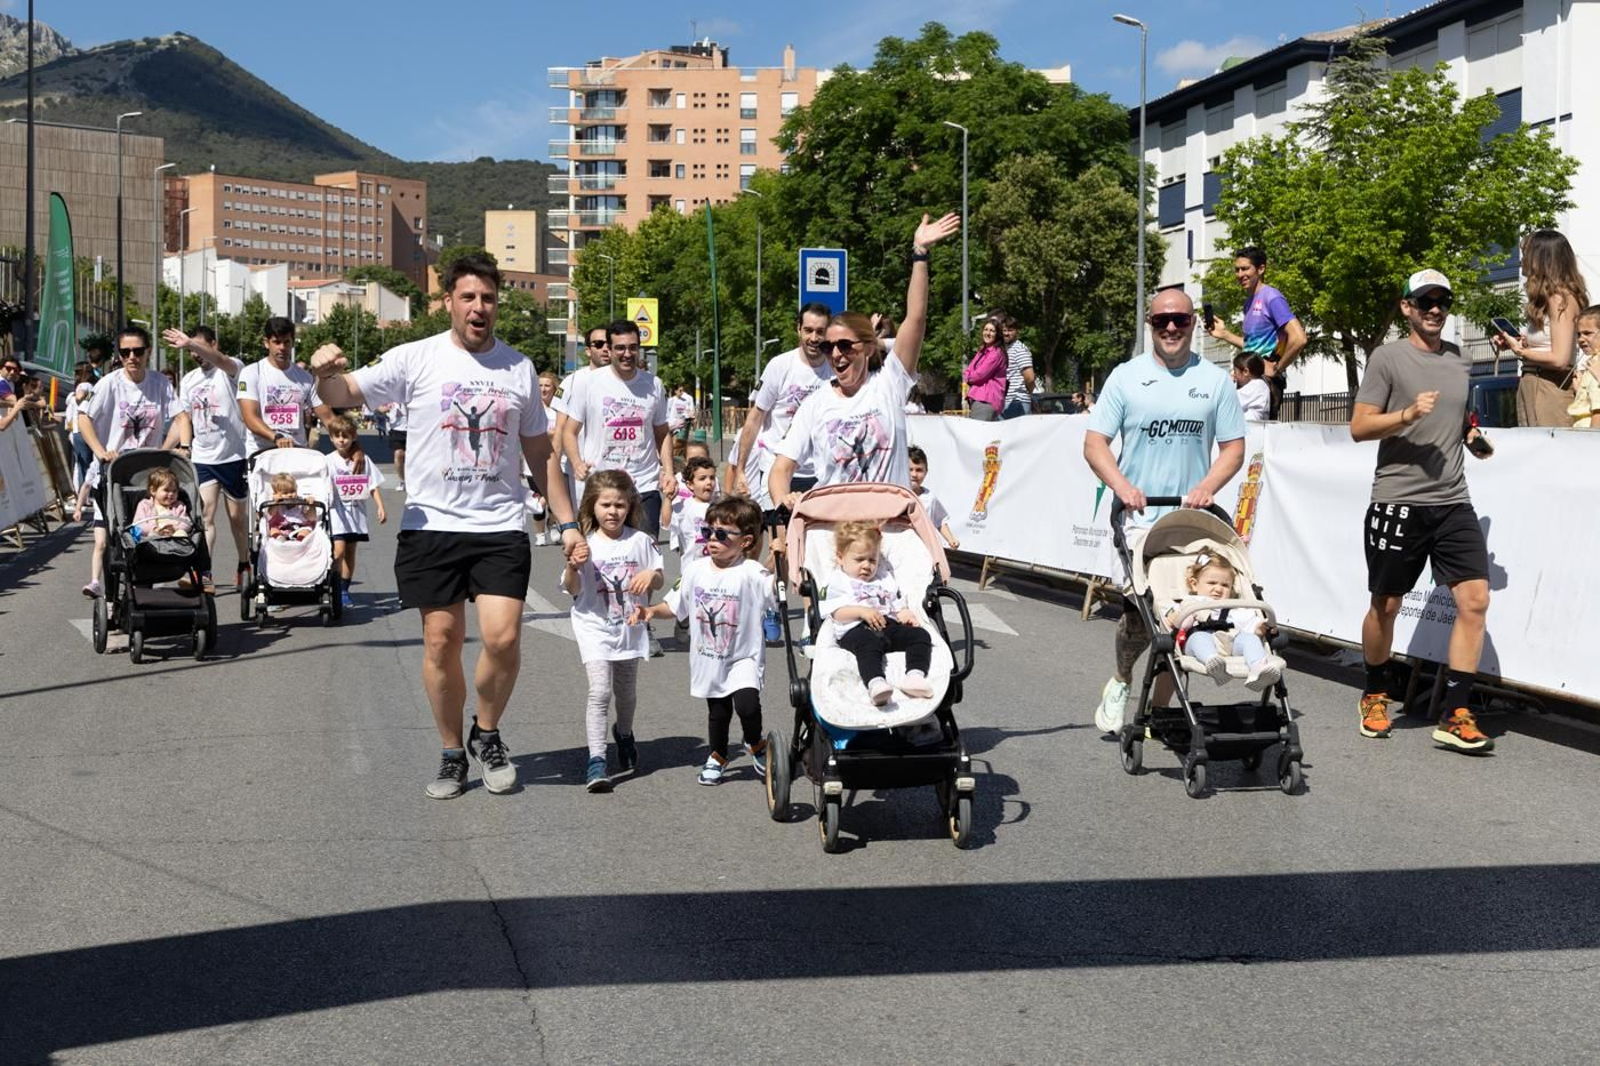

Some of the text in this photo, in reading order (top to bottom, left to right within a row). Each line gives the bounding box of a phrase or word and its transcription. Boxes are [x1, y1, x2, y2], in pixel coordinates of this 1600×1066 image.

[270, 413, 293, 425] 958
[613, 427, 636, 440] 618
[341, 484, 364, 496] 959
[1374, 503, 1409, 519] LES
[1371, 516, 1404, 537] MIL
[1400, 605, 1425, 619] eportes
[1426, 608, 1437, 621] de
